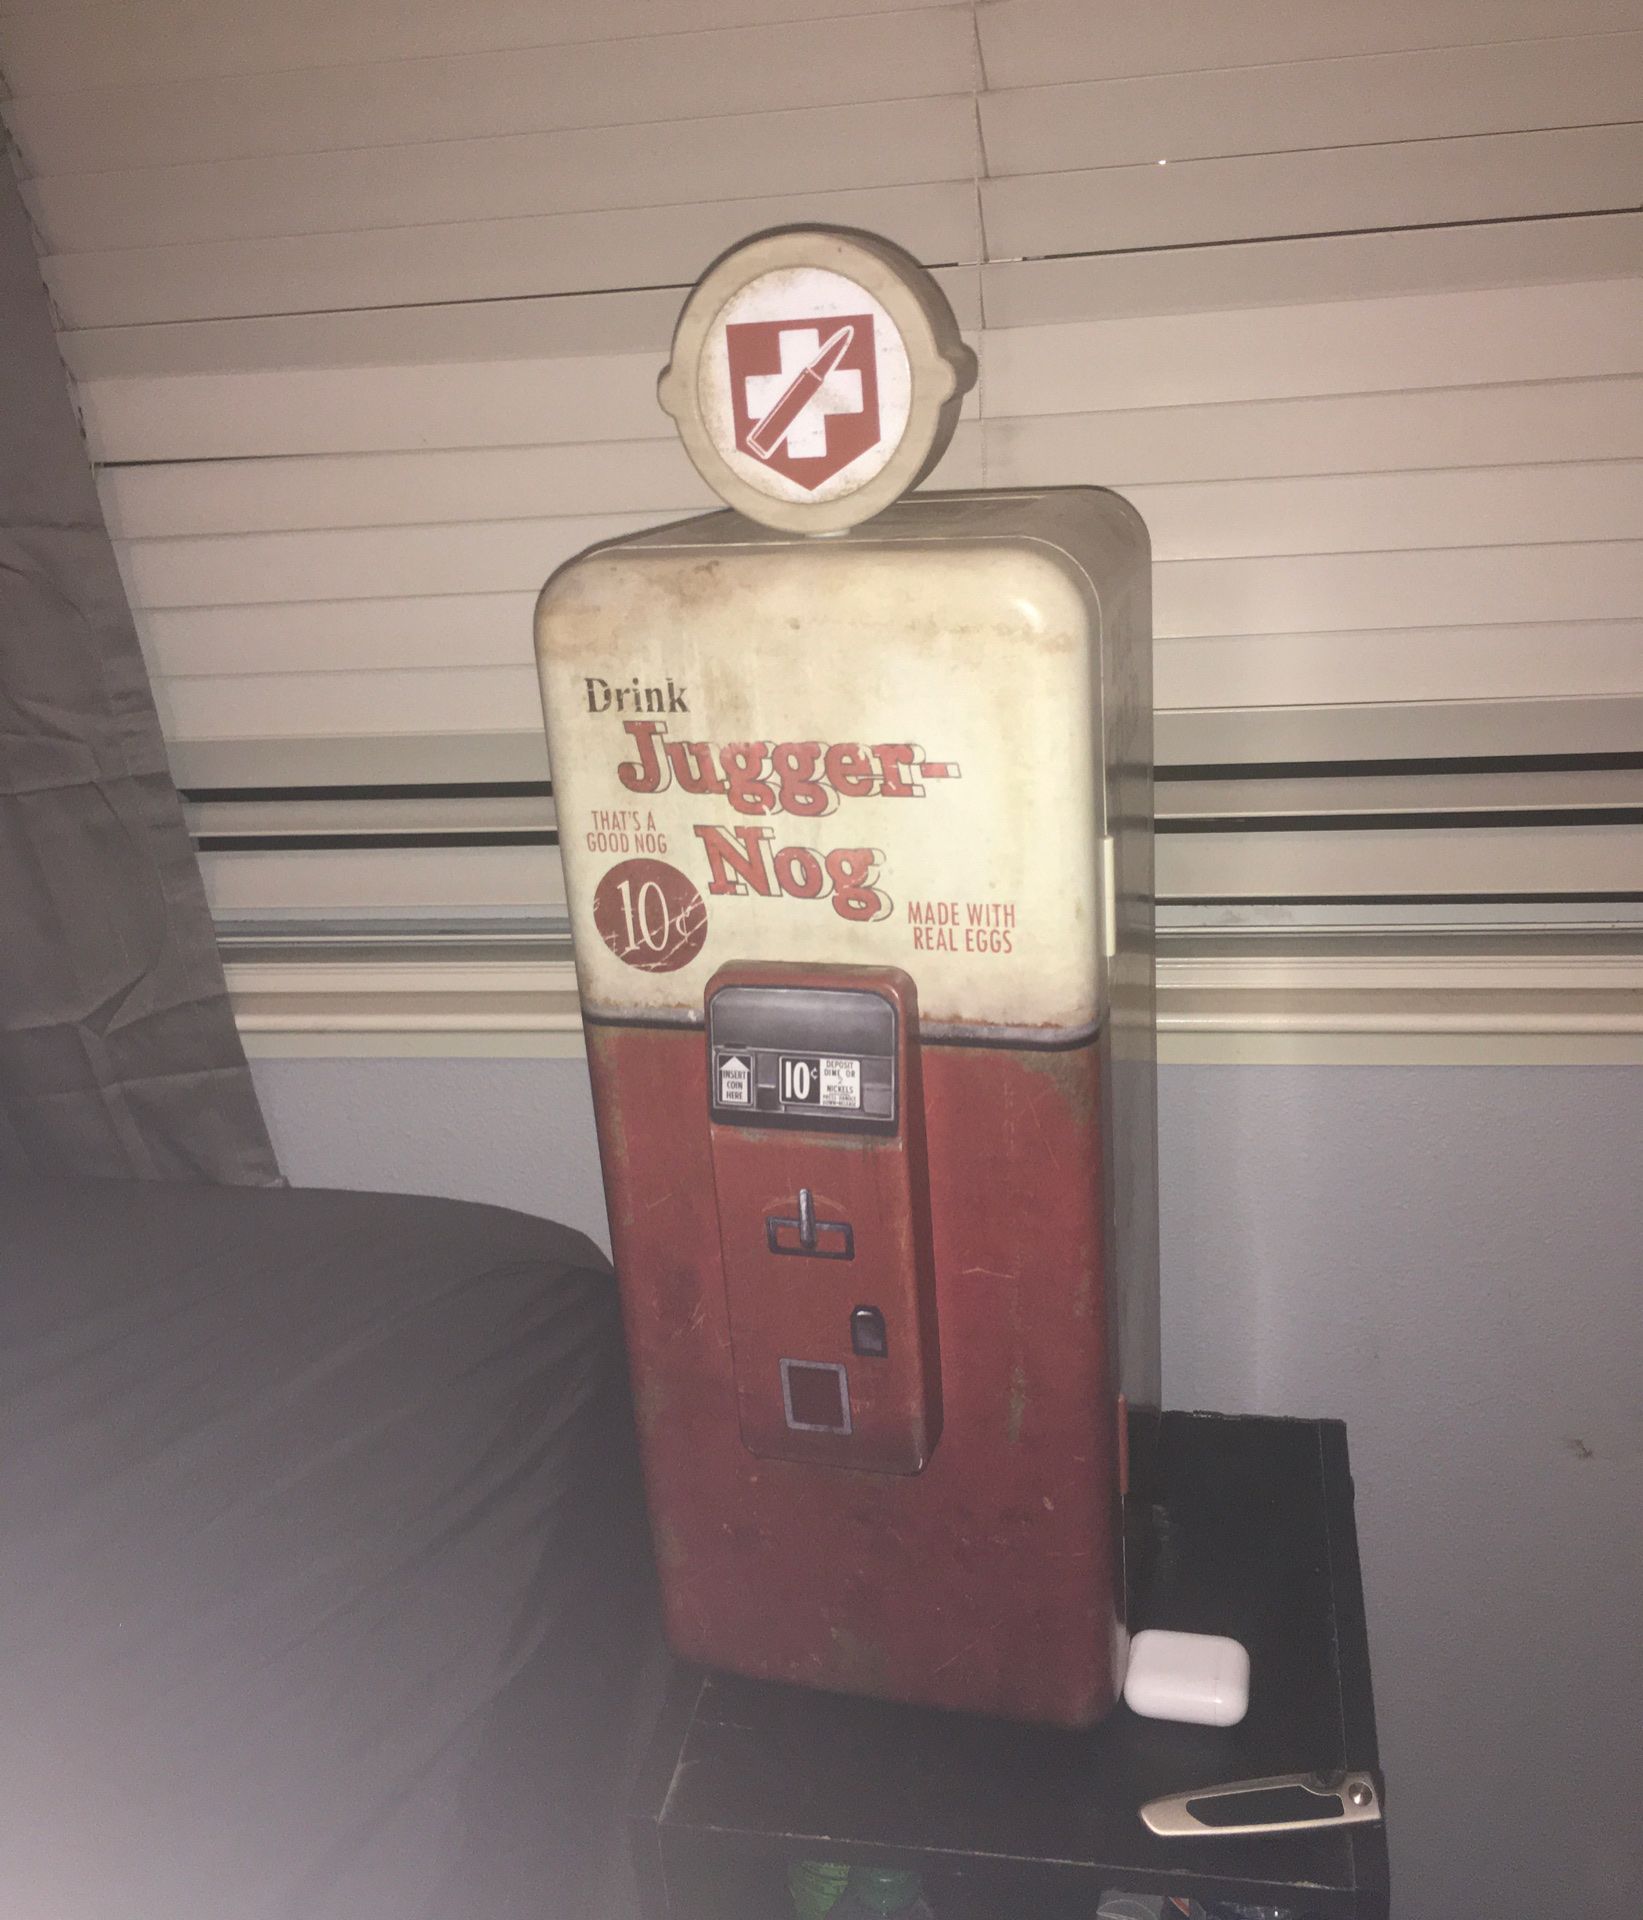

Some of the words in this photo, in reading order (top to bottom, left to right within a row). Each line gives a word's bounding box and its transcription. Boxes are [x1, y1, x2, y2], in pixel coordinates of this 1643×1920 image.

[584, 677, 690, 713] Drink
[617, 720, 962, 816] Jugger-
[591, 810, 641, 831] THAT'S
[647, 811, 657, 832] A
[586, 832, 630, 853] GOOD
[635, 833, 668, 854] NOG
[693, 824, 893, 922] Nog
[908, 901, 960, 926] MADE
[966, 903, 1015, 928] WITH
[913, 926, 959, 951] REAL
[965, 928, 1013, 953] EGGS
[723, 1070, 746, 1080] INSERT
[826, 1060, 854, 1069] DEPOSIT
[726, 1081, 743, 1090] COIN
[726, 1091, 743, 1100] HERE
